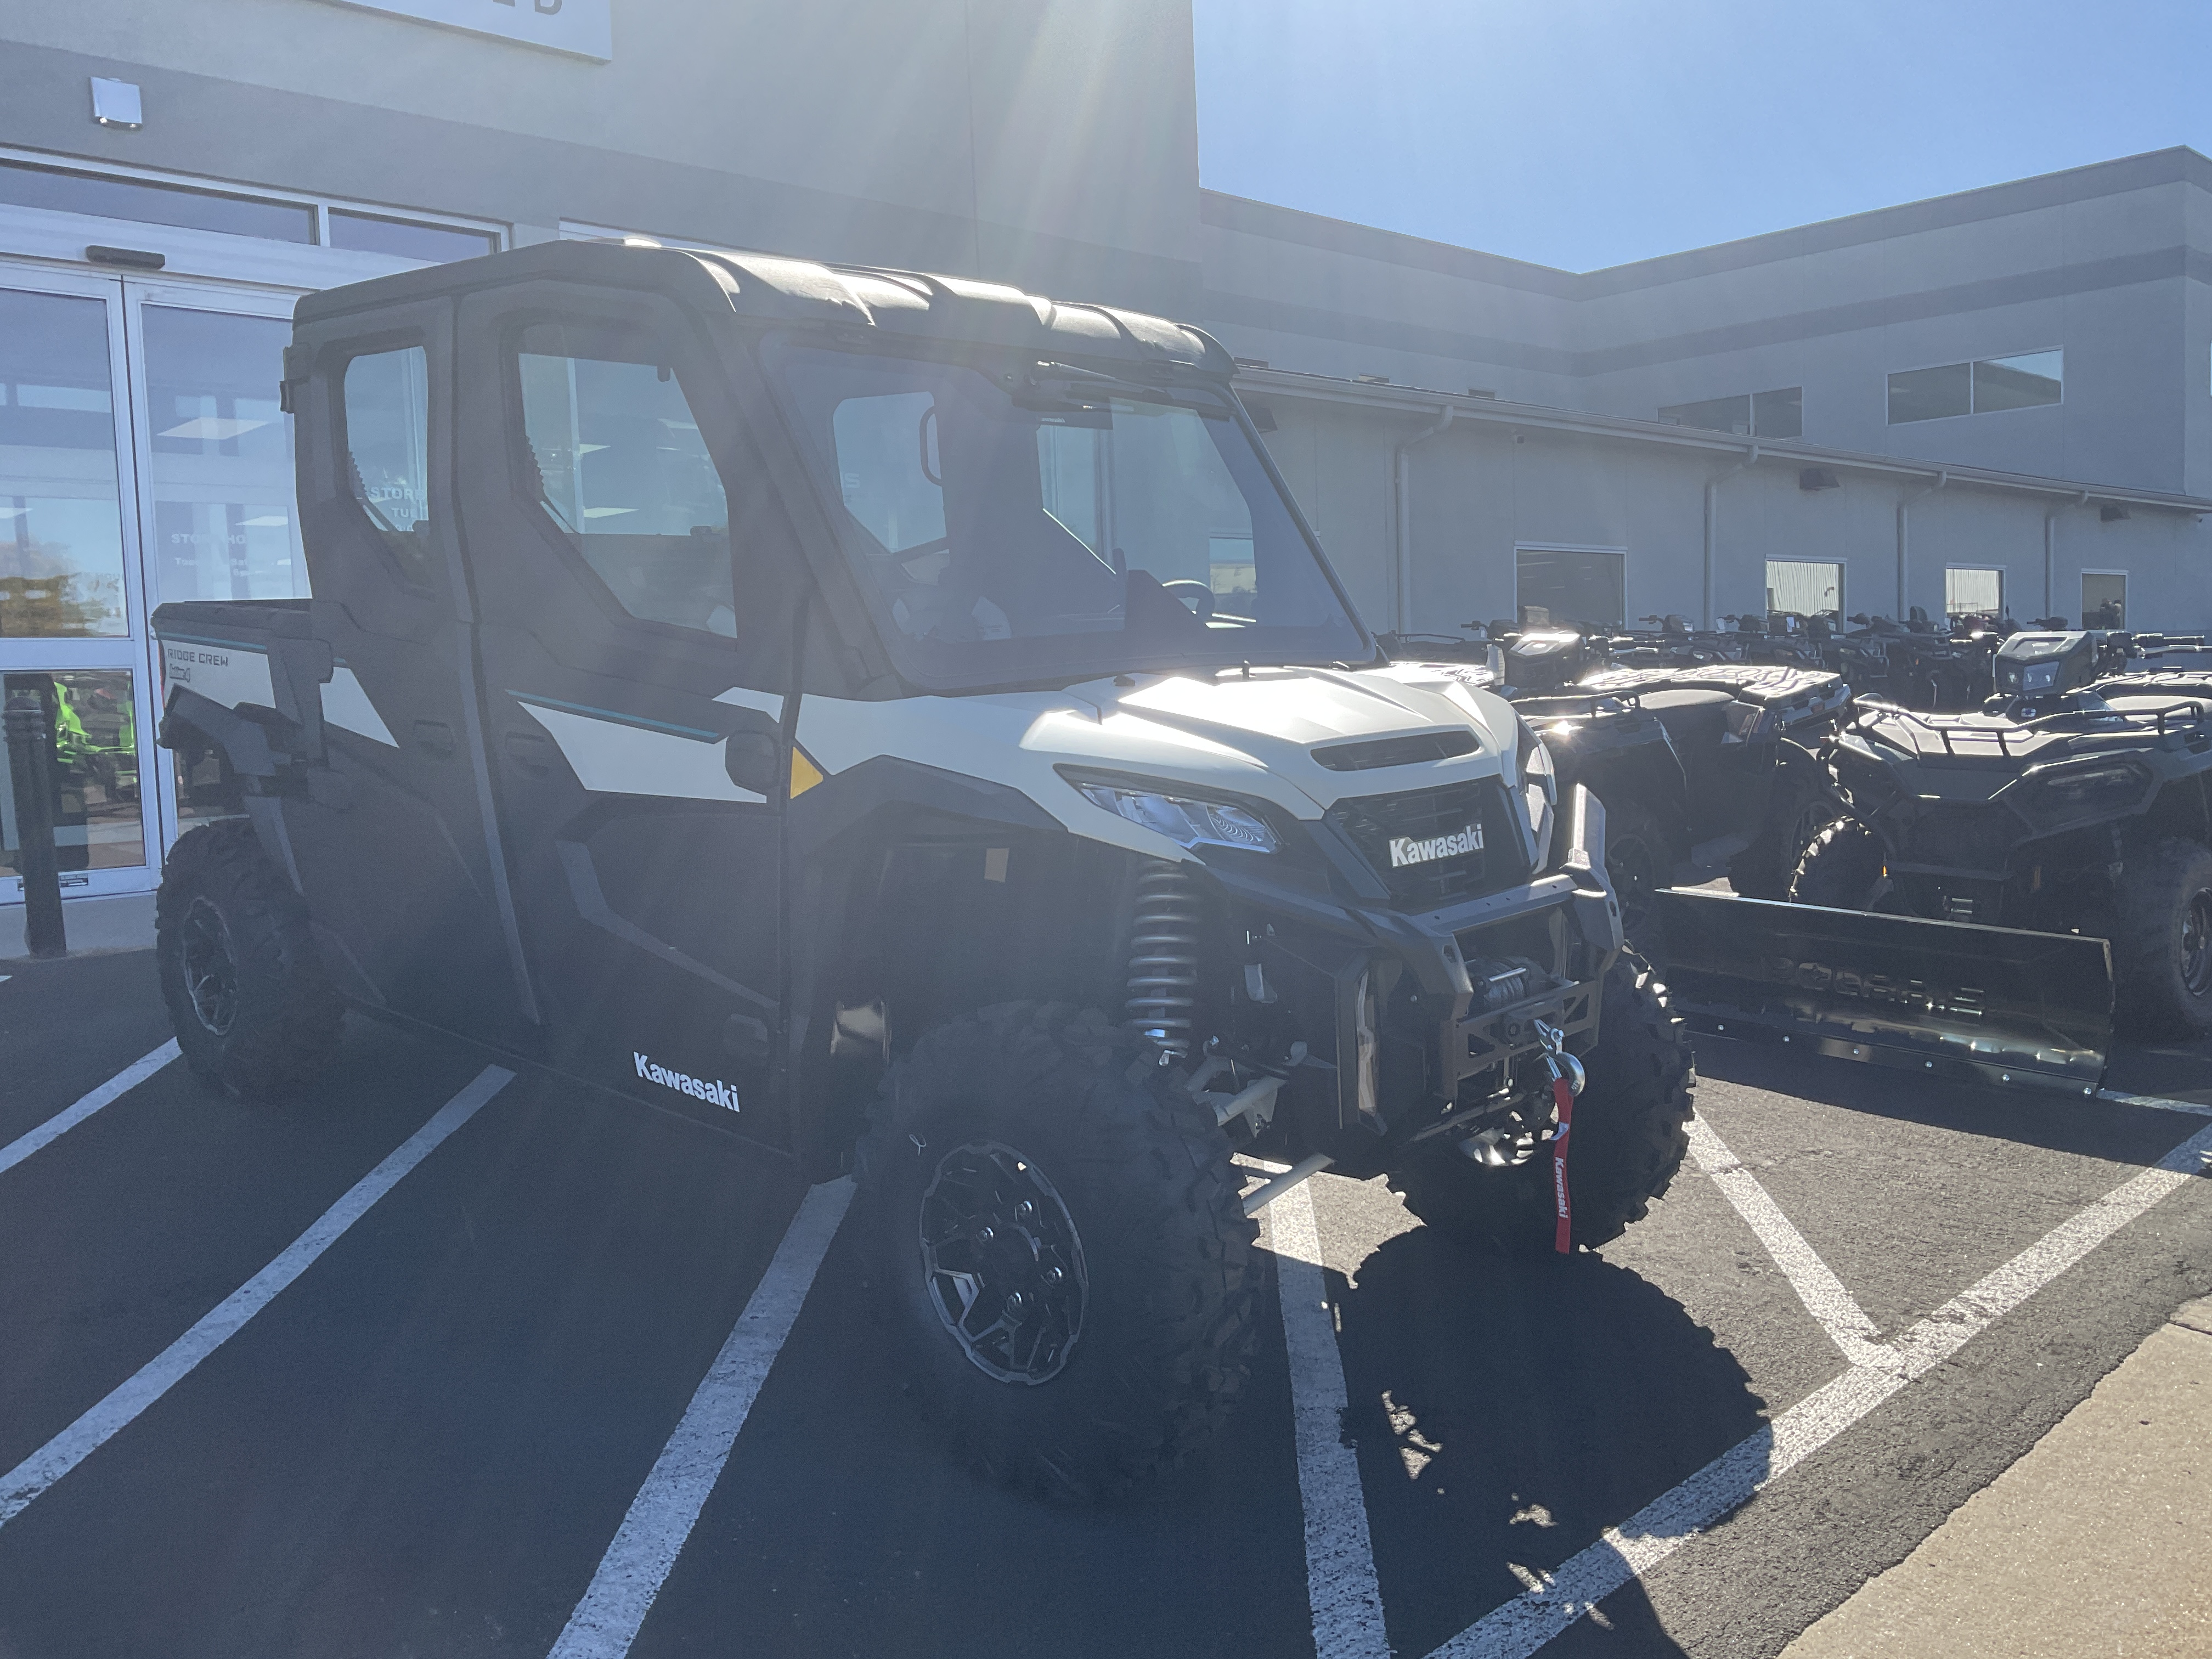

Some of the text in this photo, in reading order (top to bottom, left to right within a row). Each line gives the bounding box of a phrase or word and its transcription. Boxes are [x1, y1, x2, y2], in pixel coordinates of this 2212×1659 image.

[168, 648, 228, 666] RIDGE CREW
[1390, 823, 1483, 867] Kawasaki
[634, 1051, 740, 1113] Kawasaki
[1555, 1157, 1568, 1218] Kawasaki
